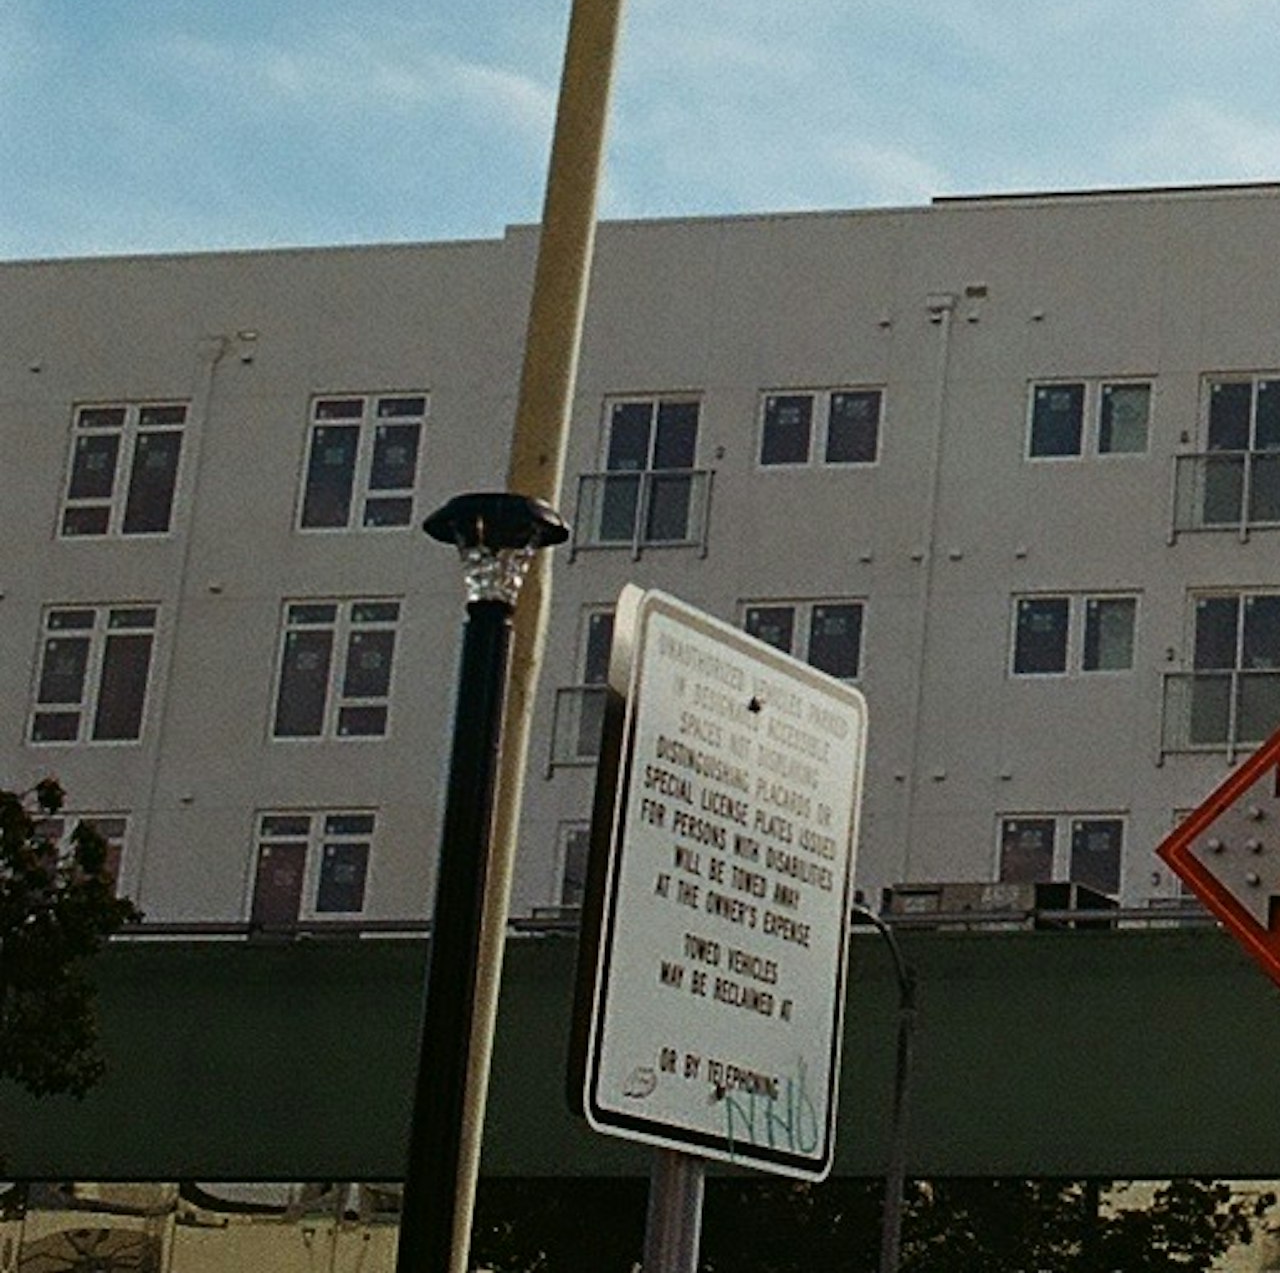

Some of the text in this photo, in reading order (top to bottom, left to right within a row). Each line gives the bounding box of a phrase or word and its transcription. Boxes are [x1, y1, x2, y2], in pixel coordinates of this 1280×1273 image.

[644, 765, 836, 861] SPECIAL LICENSE PLATES ISSUED
[756, 778, 810, 818] PLACARDS
[641, 798, 833, 891] FOR PERSONS WITH DISABILITIES
[674, 845, 799, 911] WILL BE TOWED AWAY
[654, 872, 810, 949] AT THE OWNER'S EXPENSE
[683, 933, 778, 985] TOWED VEHICLES
[660, 961, 792, 1022] MAY BE RECLAIMED AT
[659, 1047, 778, 1101] OR BY TELEPHONING
